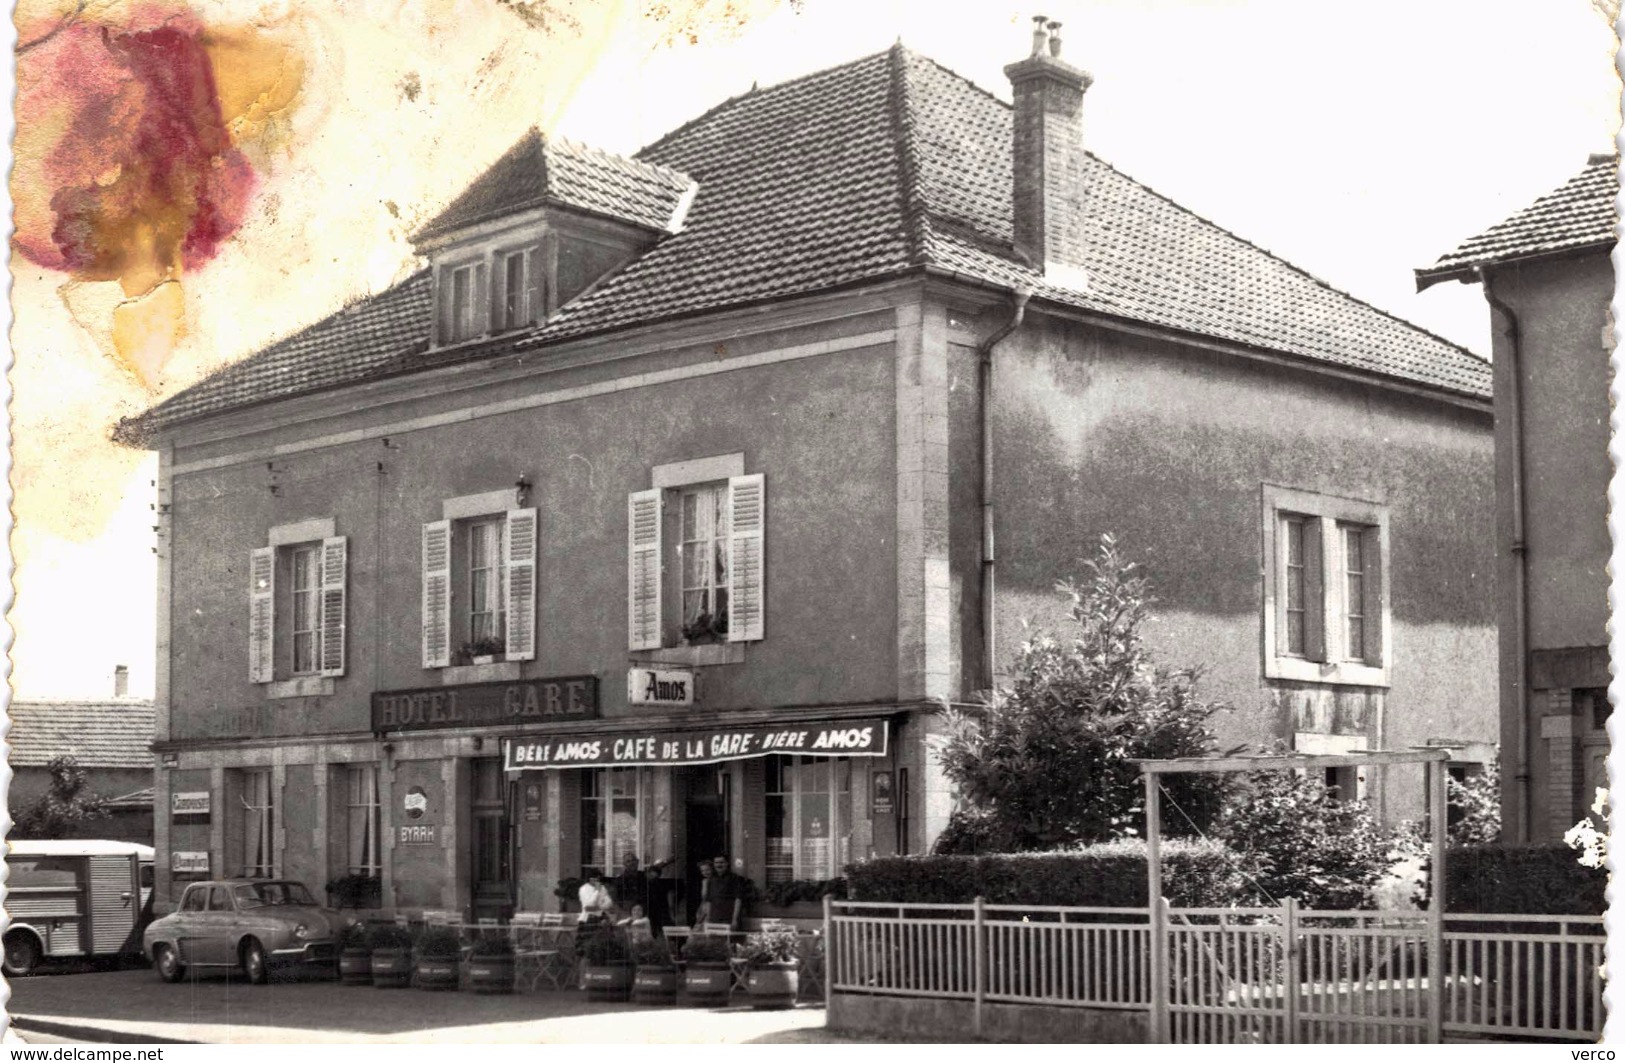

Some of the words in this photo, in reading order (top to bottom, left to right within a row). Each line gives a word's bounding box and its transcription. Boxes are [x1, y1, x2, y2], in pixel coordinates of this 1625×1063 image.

[645, 671, 686, 701] Amos
[382, 691, 463, 726] HOTEL
[504, 681, 586, 716] GARE
[553, 741, 602, 761] AMOS
[613, 736, 657, 760] CAFÉ
[662, 741, 679, 759] DE
[686, 740, 704, 759] LA
[711, 733, 755, 756] GARE
[811, 727, 873, 749] AMOS
